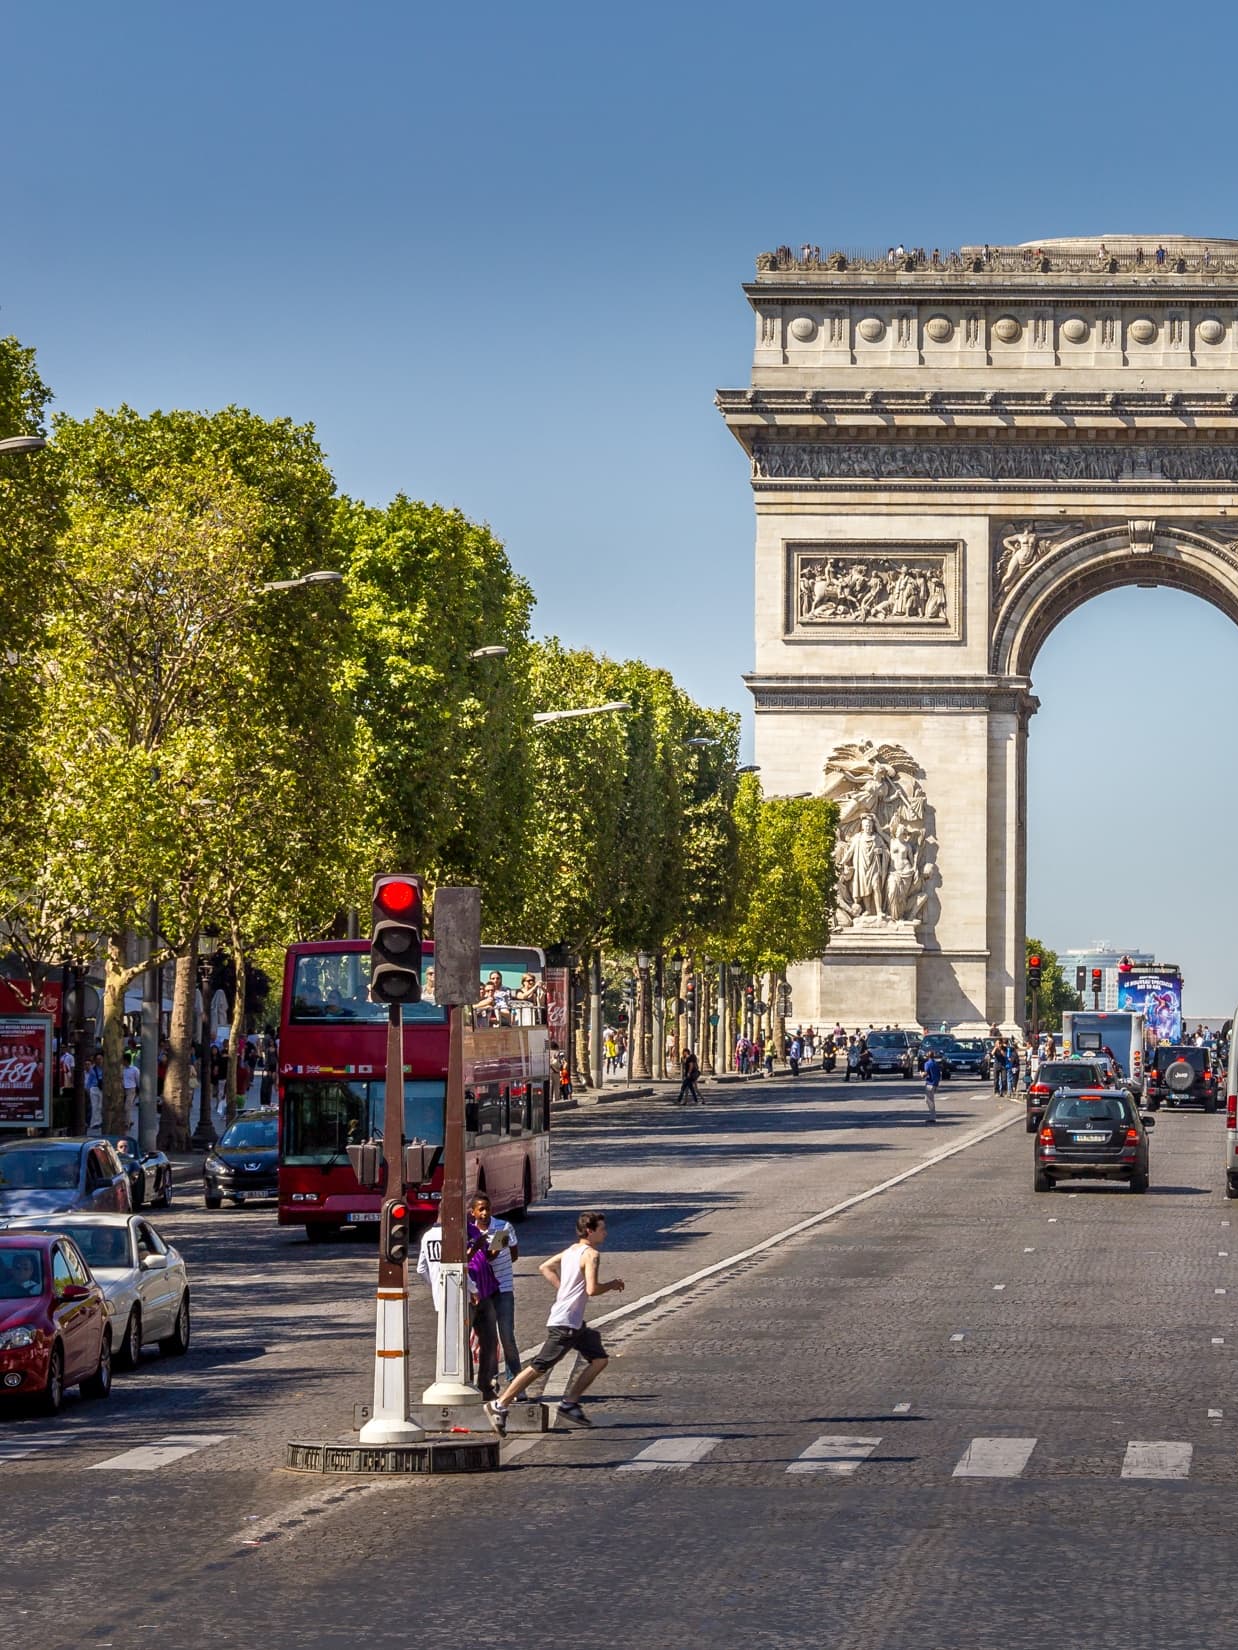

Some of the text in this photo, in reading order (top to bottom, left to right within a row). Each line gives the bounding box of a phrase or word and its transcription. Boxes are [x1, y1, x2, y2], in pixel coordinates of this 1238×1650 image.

[428, 1240, 441, 1262] 10
[361, 1407, 369, 1418] 5
[441, 1407, 449, 1418] 5
[528, 1407, 535, 1418] 5
